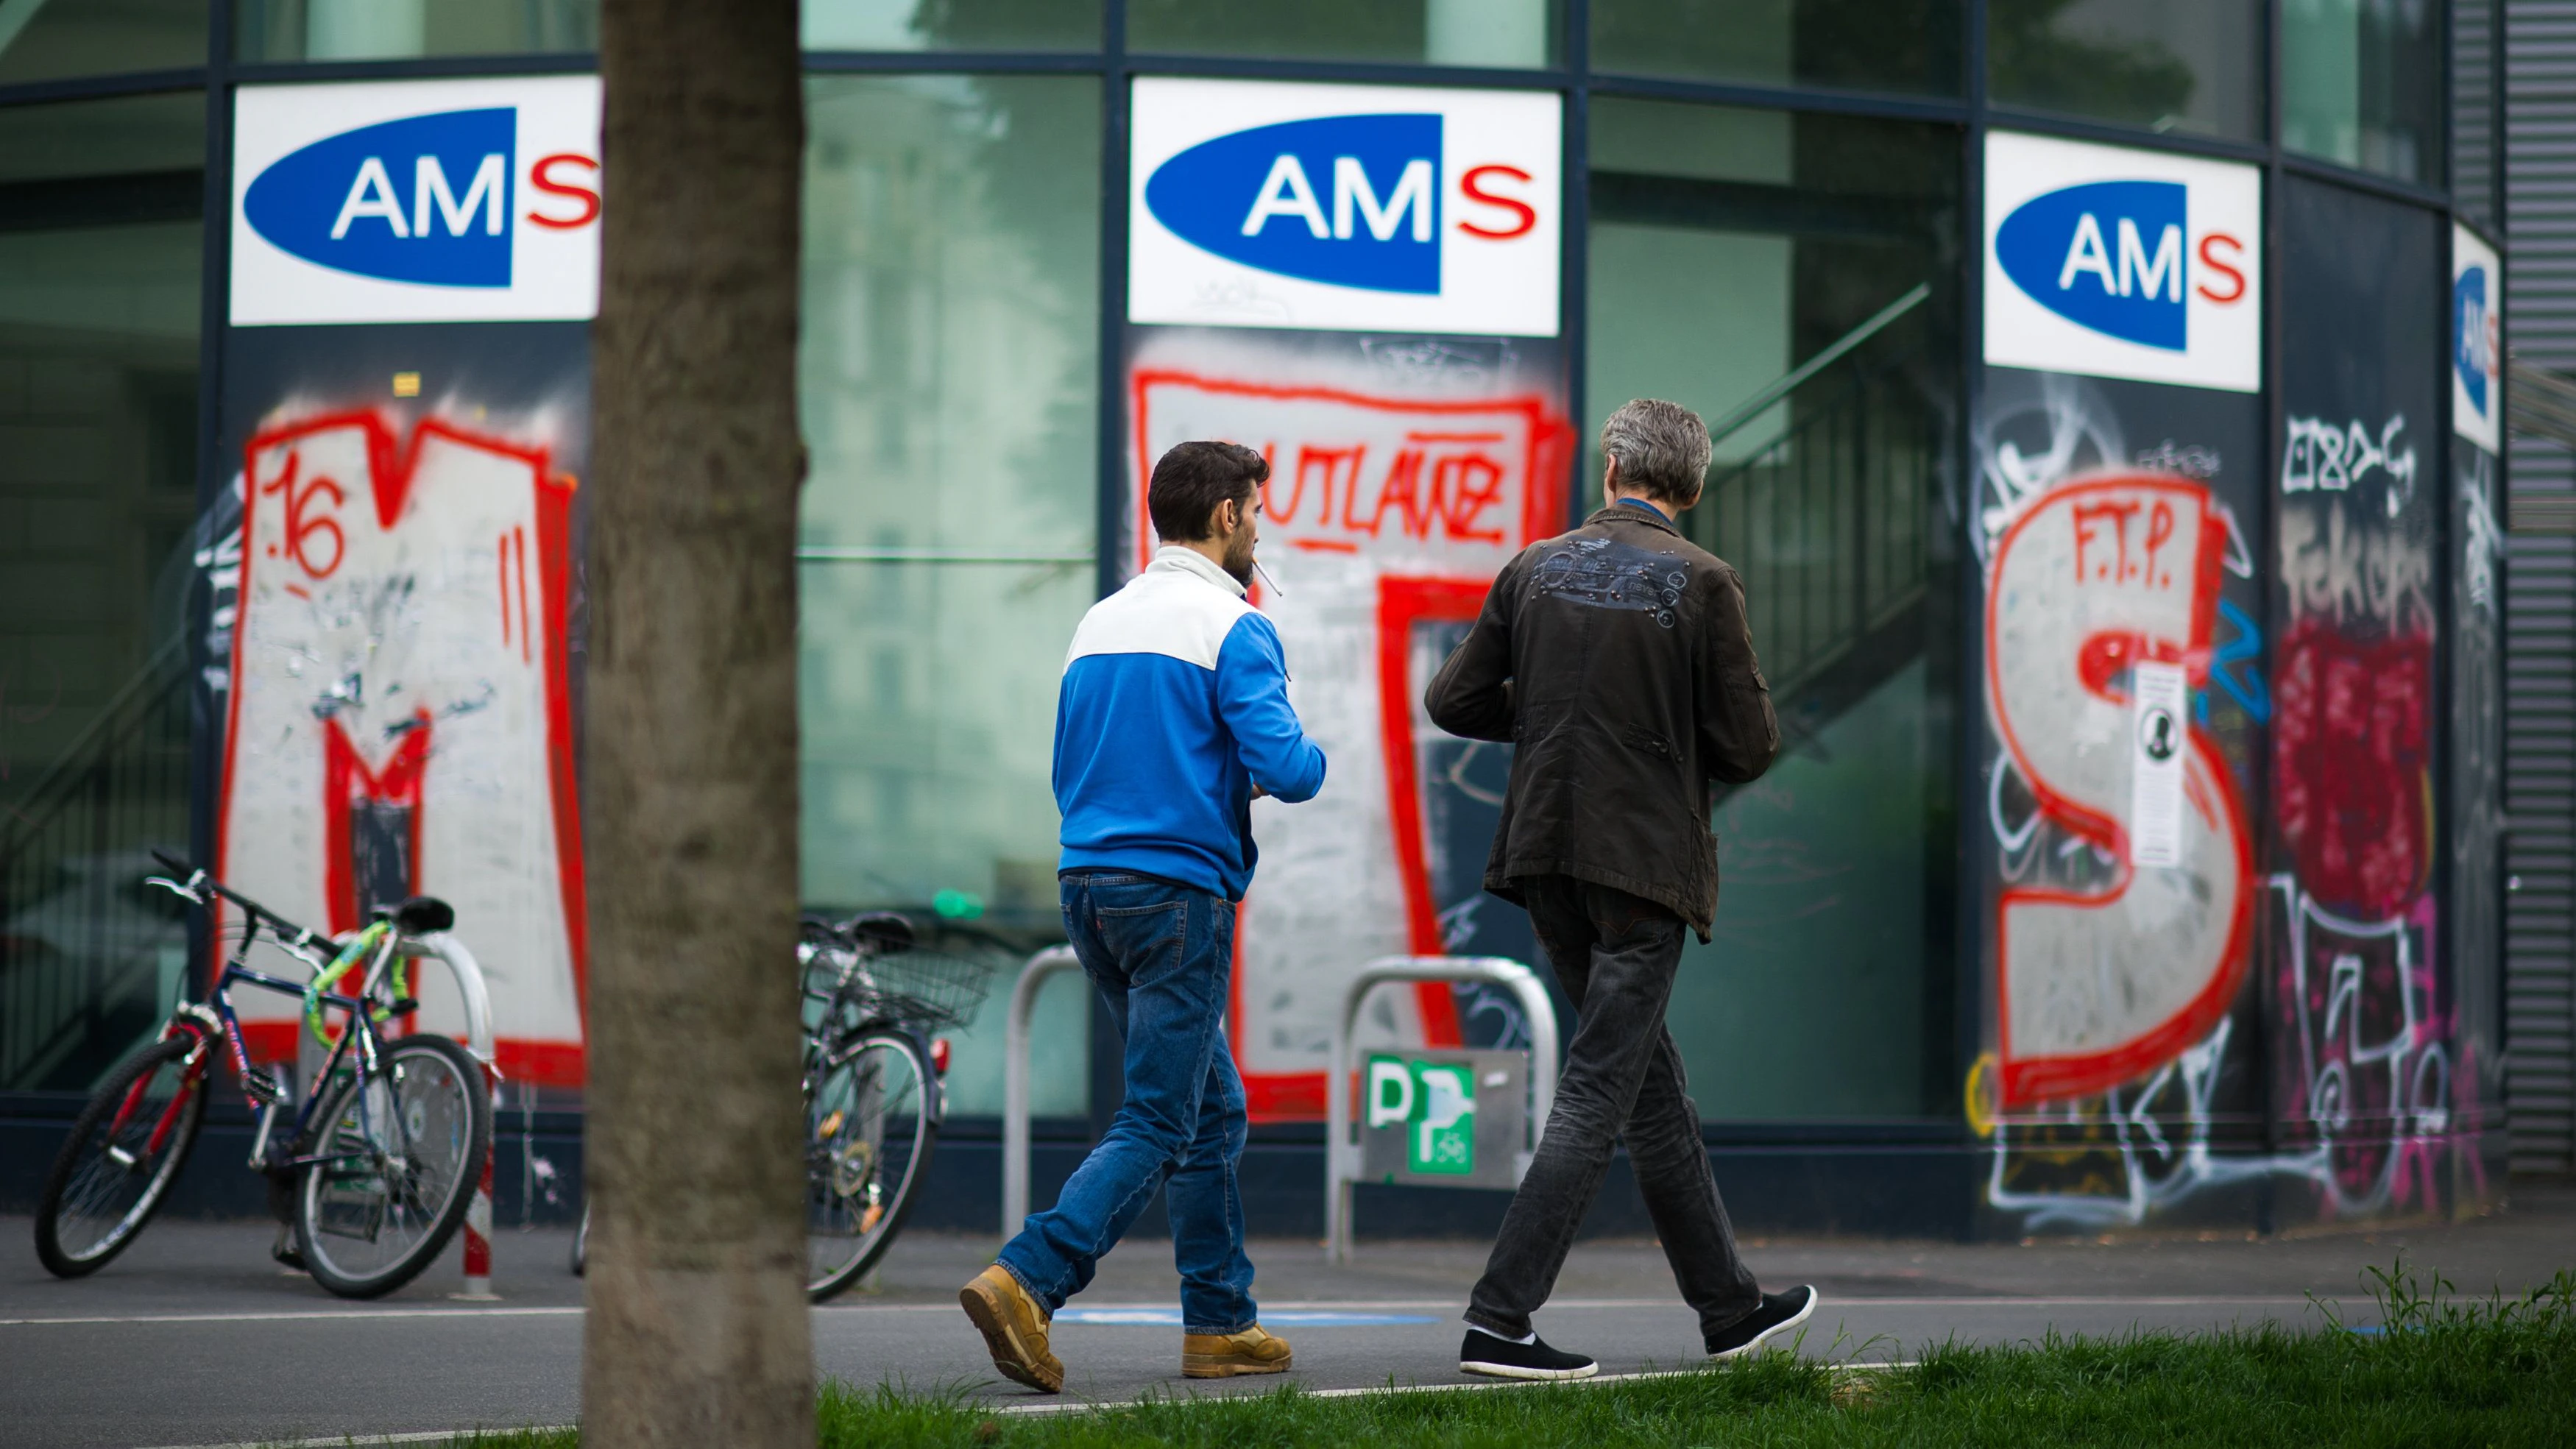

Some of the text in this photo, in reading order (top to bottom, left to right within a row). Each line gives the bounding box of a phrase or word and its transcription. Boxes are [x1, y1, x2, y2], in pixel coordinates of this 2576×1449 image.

[330, 153, 601, 240] AMS
[1241, 154, 1538, 243] AMS
[2058, 213, 2247, 305] AMS
[1628, 580, 1660, 598] never
